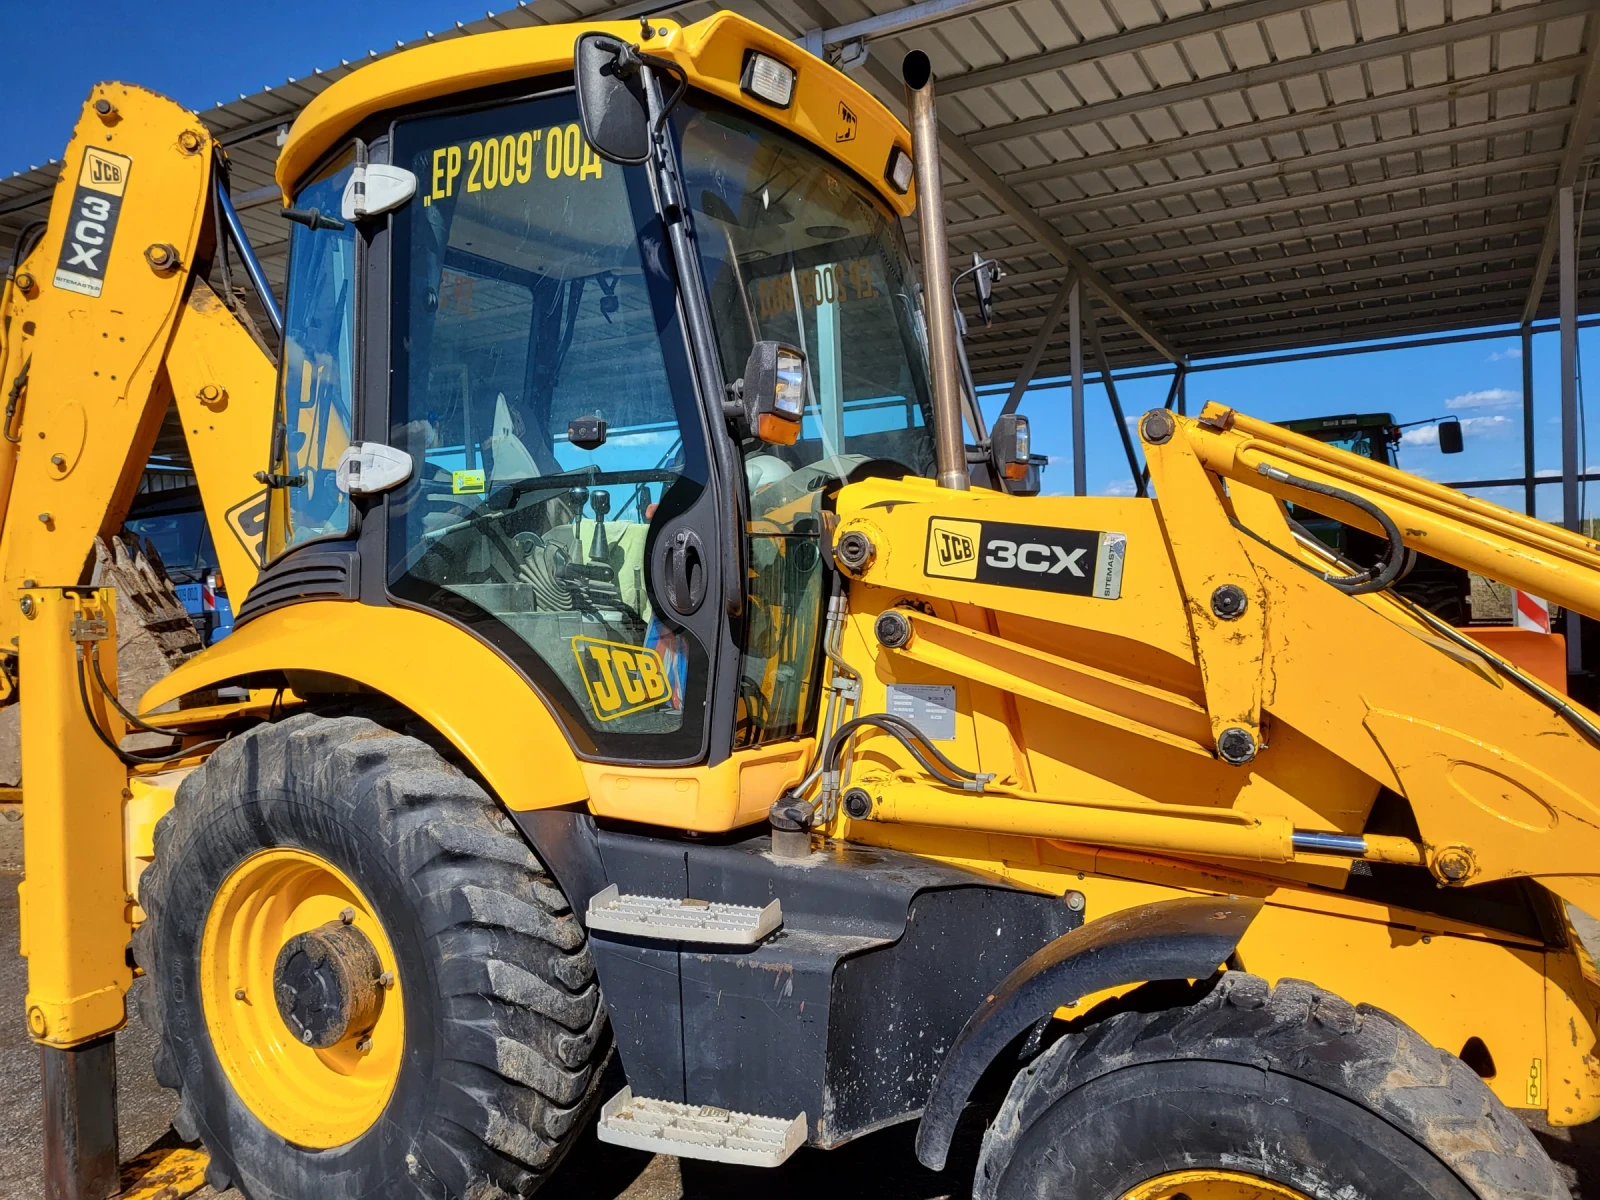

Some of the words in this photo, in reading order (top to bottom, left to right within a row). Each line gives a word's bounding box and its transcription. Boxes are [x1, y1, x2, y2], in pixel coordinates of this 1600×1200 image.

[93, 159, 120, 181] JCB
[66, 196, 111, 271] 3CX
[55, 275, 101, 292] SITEMASTER
[940, 533, 972, 563] JCB
[985, 540, 1088, 577] 3CX
[589, 646, 665, 712] JCB
